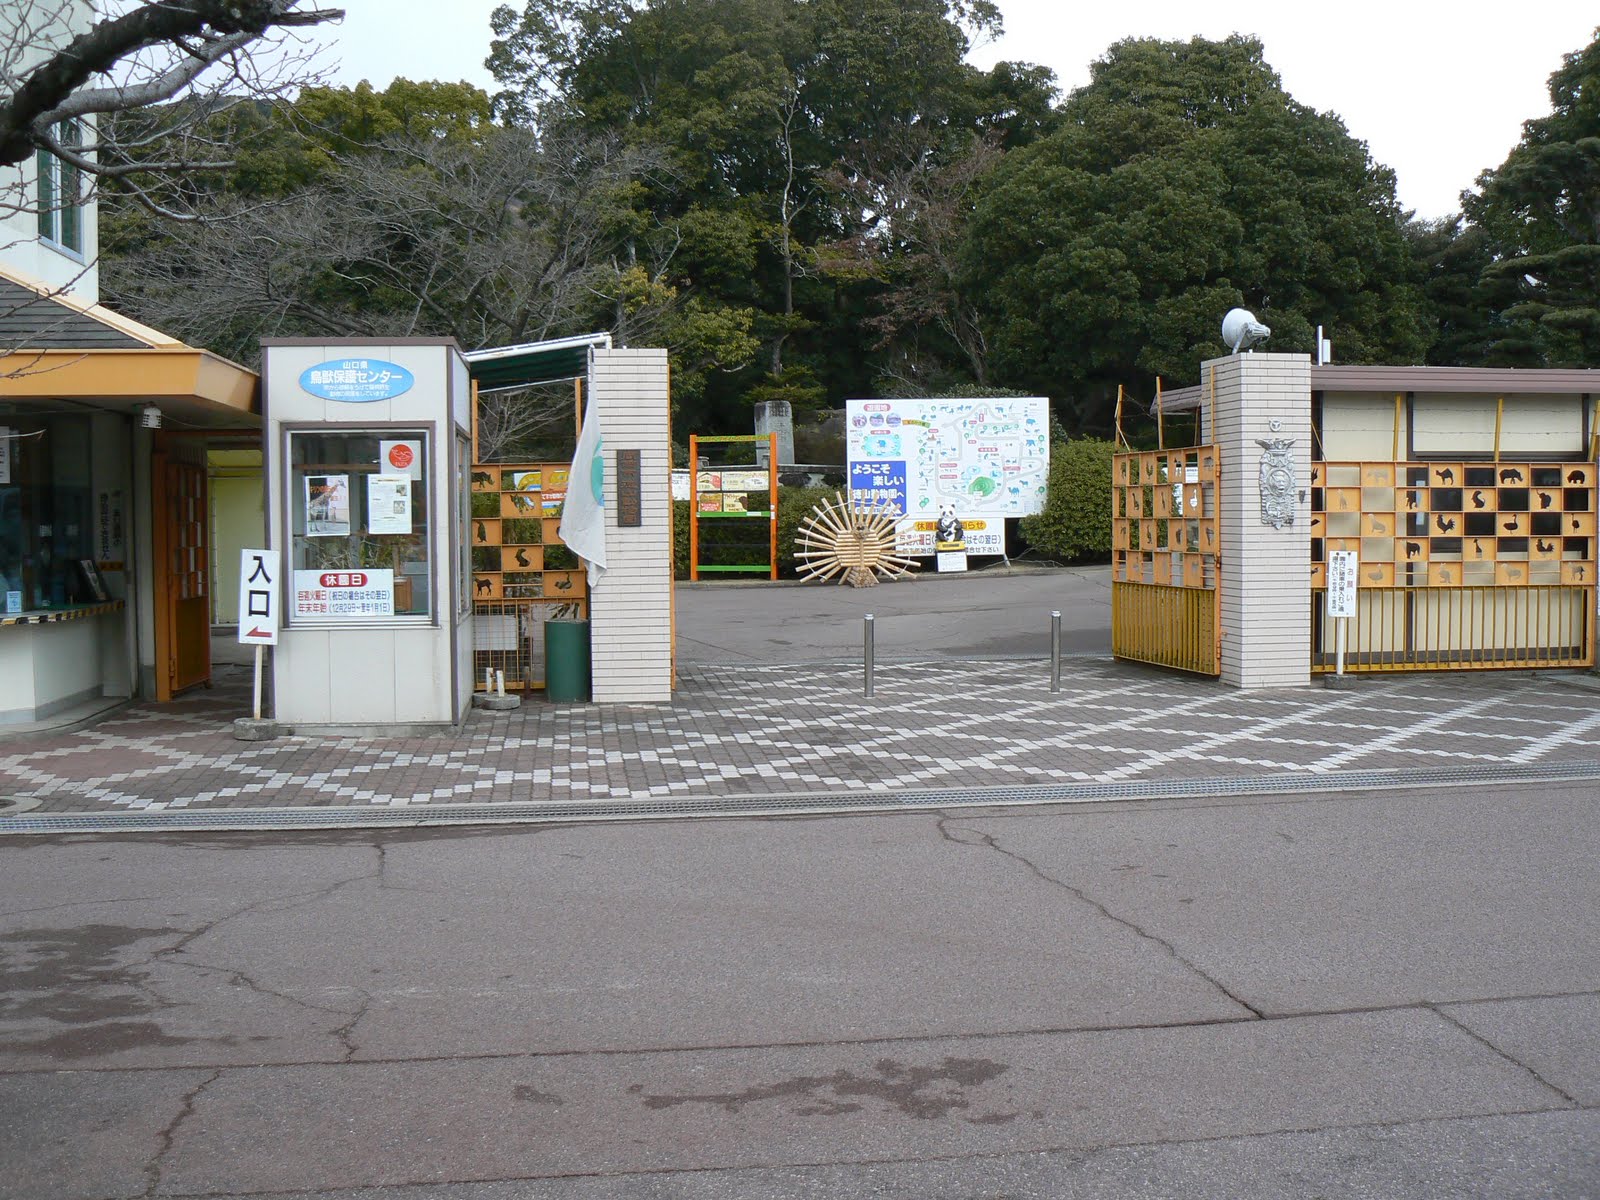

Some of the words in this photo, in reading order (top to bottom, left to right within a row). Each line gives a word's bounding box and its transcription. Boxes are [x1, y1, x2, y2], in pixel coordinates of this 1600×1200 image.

[342, 361, 368, 369] 山口県
[310, 370, 403, 384] 鳥獣保護センター
[852, 464, 891, 475] ようこそ
[872, 476, 904, 486] 楽しい
[248, 555, 273, 618] 入口
[325, 574, 362, 587] 休園日
